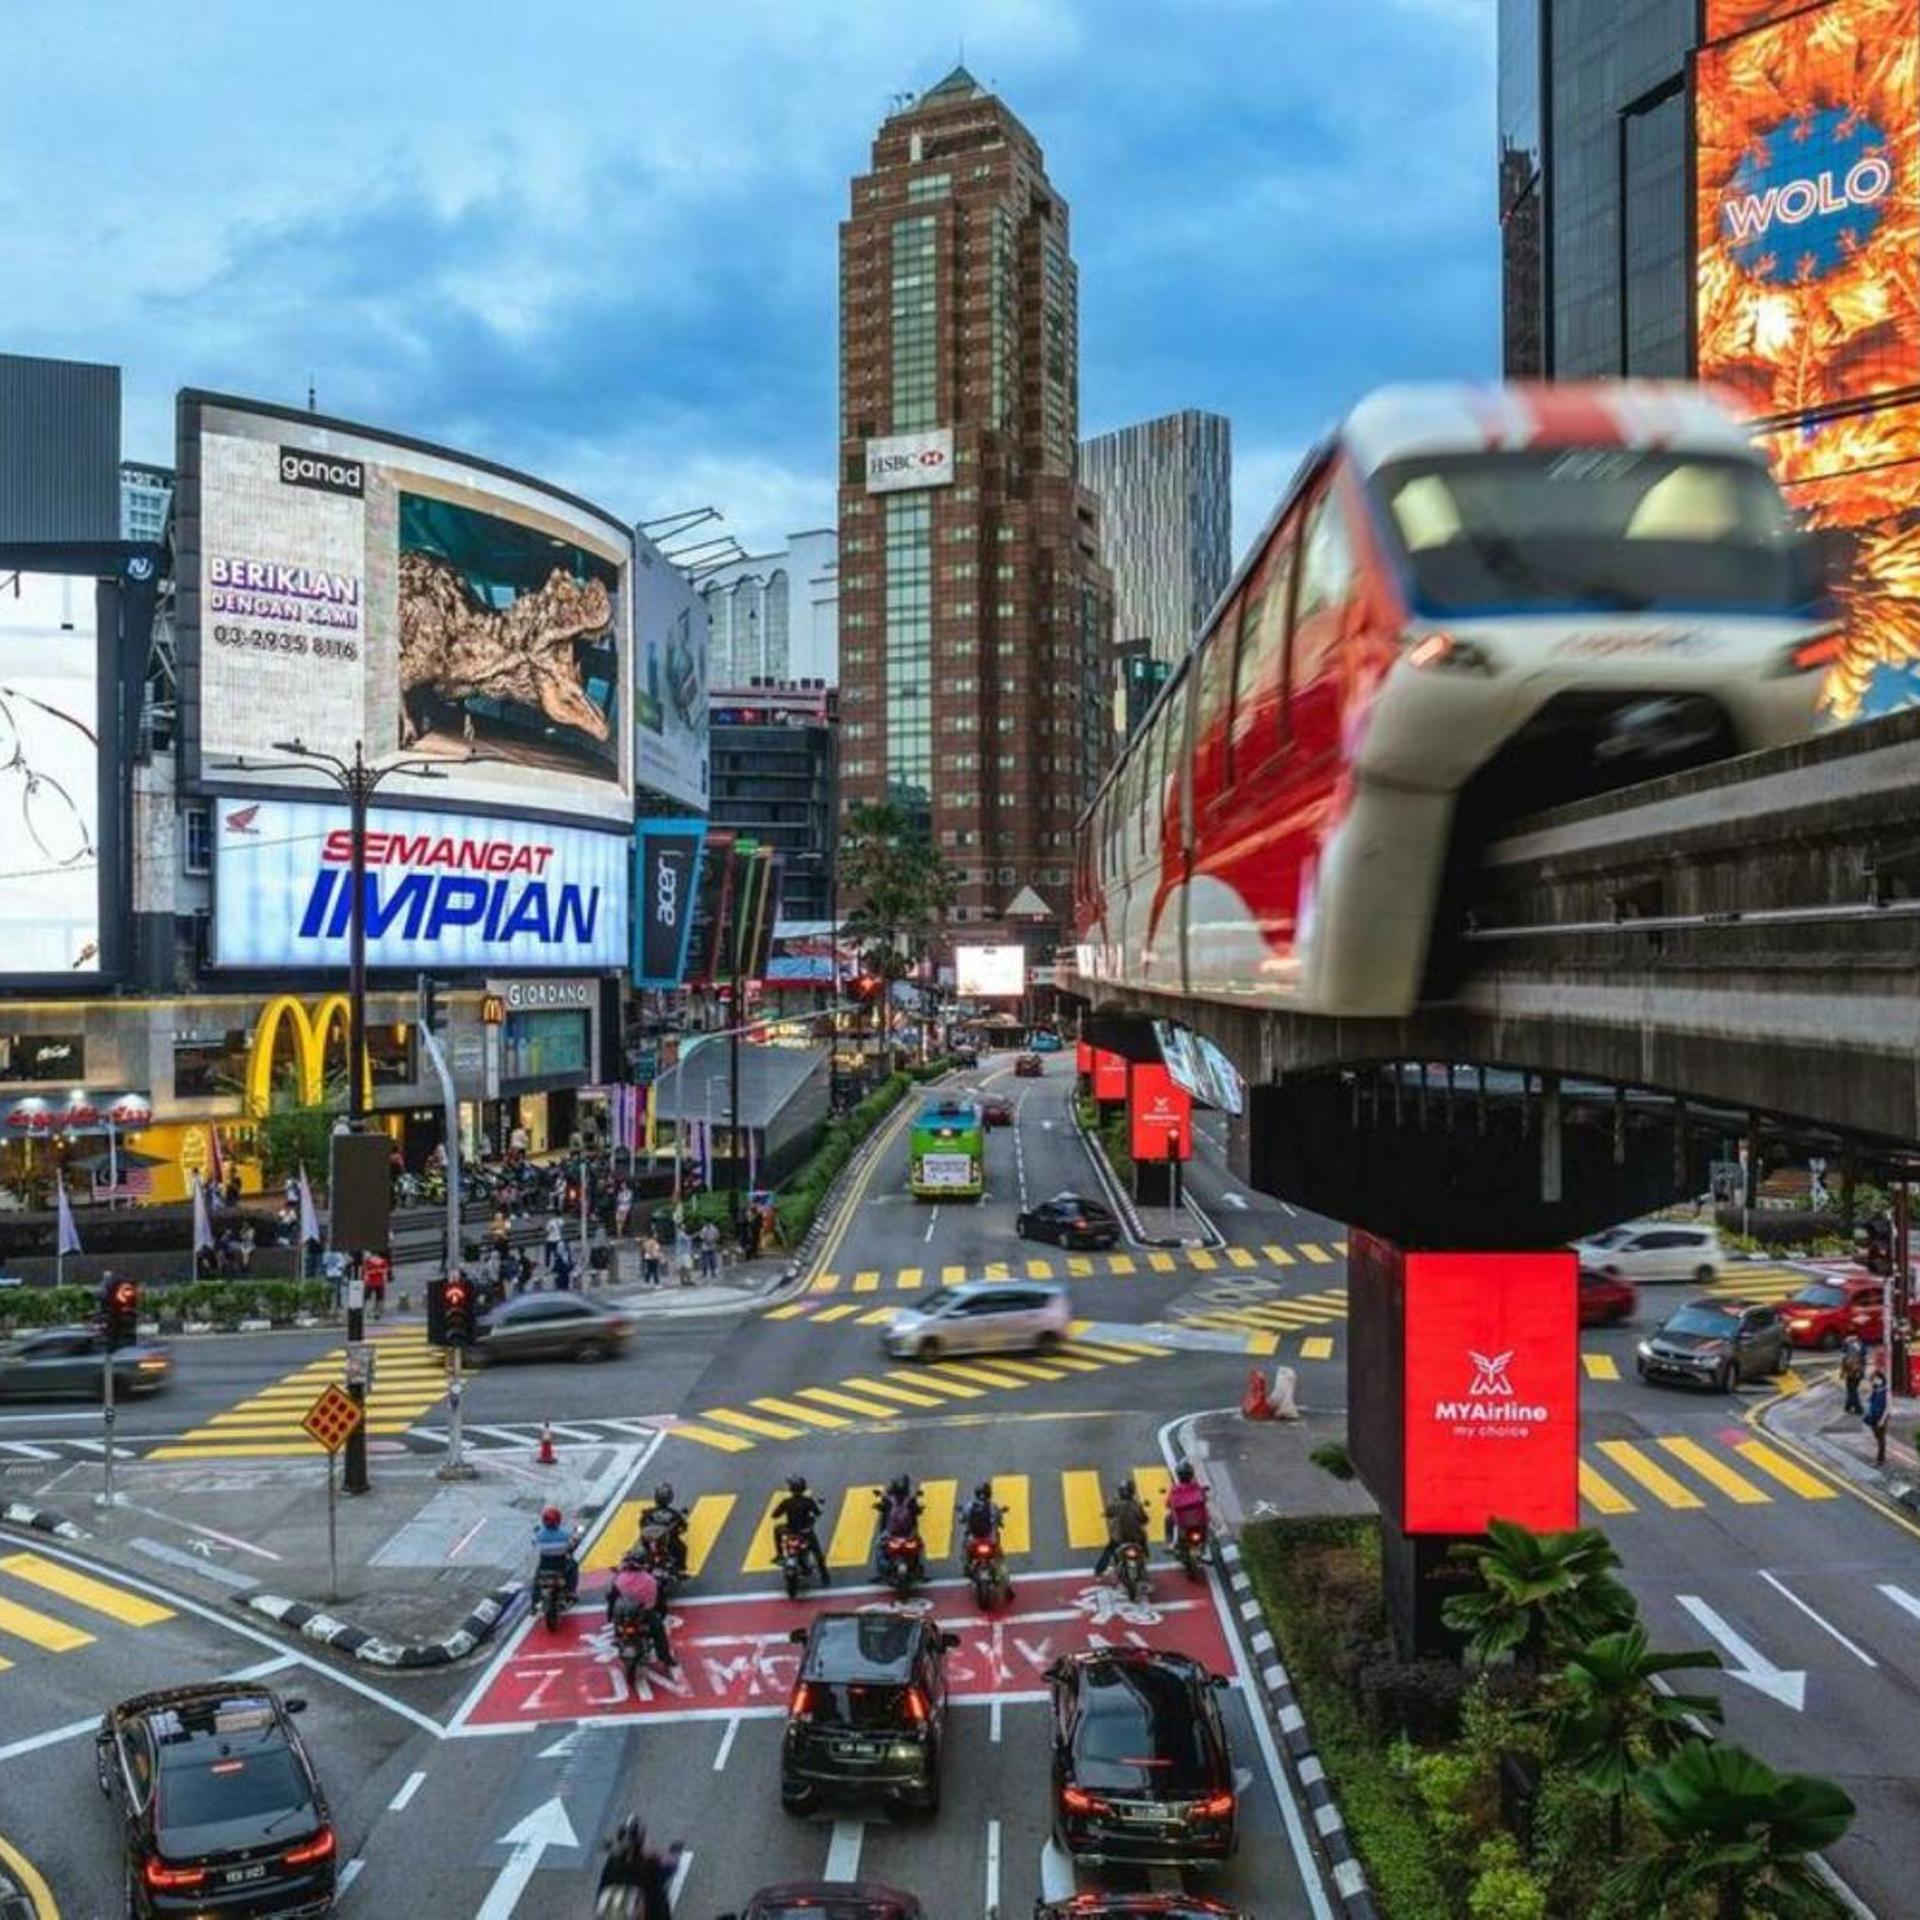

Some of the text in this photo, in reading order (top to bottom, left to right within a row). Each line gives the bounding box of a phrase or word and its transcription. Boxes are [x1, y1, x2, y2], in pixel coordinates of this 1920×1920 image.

[1725, 158, 1891, 242] WOLO
[282, 455, 361, 487] ganad
[872, 453, 917, 474] HSBC
[211, 557, 358, 606] BERIKLAN
[211, 593, 358, 630] DENGAN KAMI
[322, 829, 553, 876] SEMANGAT
[299, 868, 600, 944] IMPIAN
[656, 856, 677, 926] acer
[509, 983, 586, 1005] GIORDANO
[1435, 1402, 1549, 1422] MYAirline
